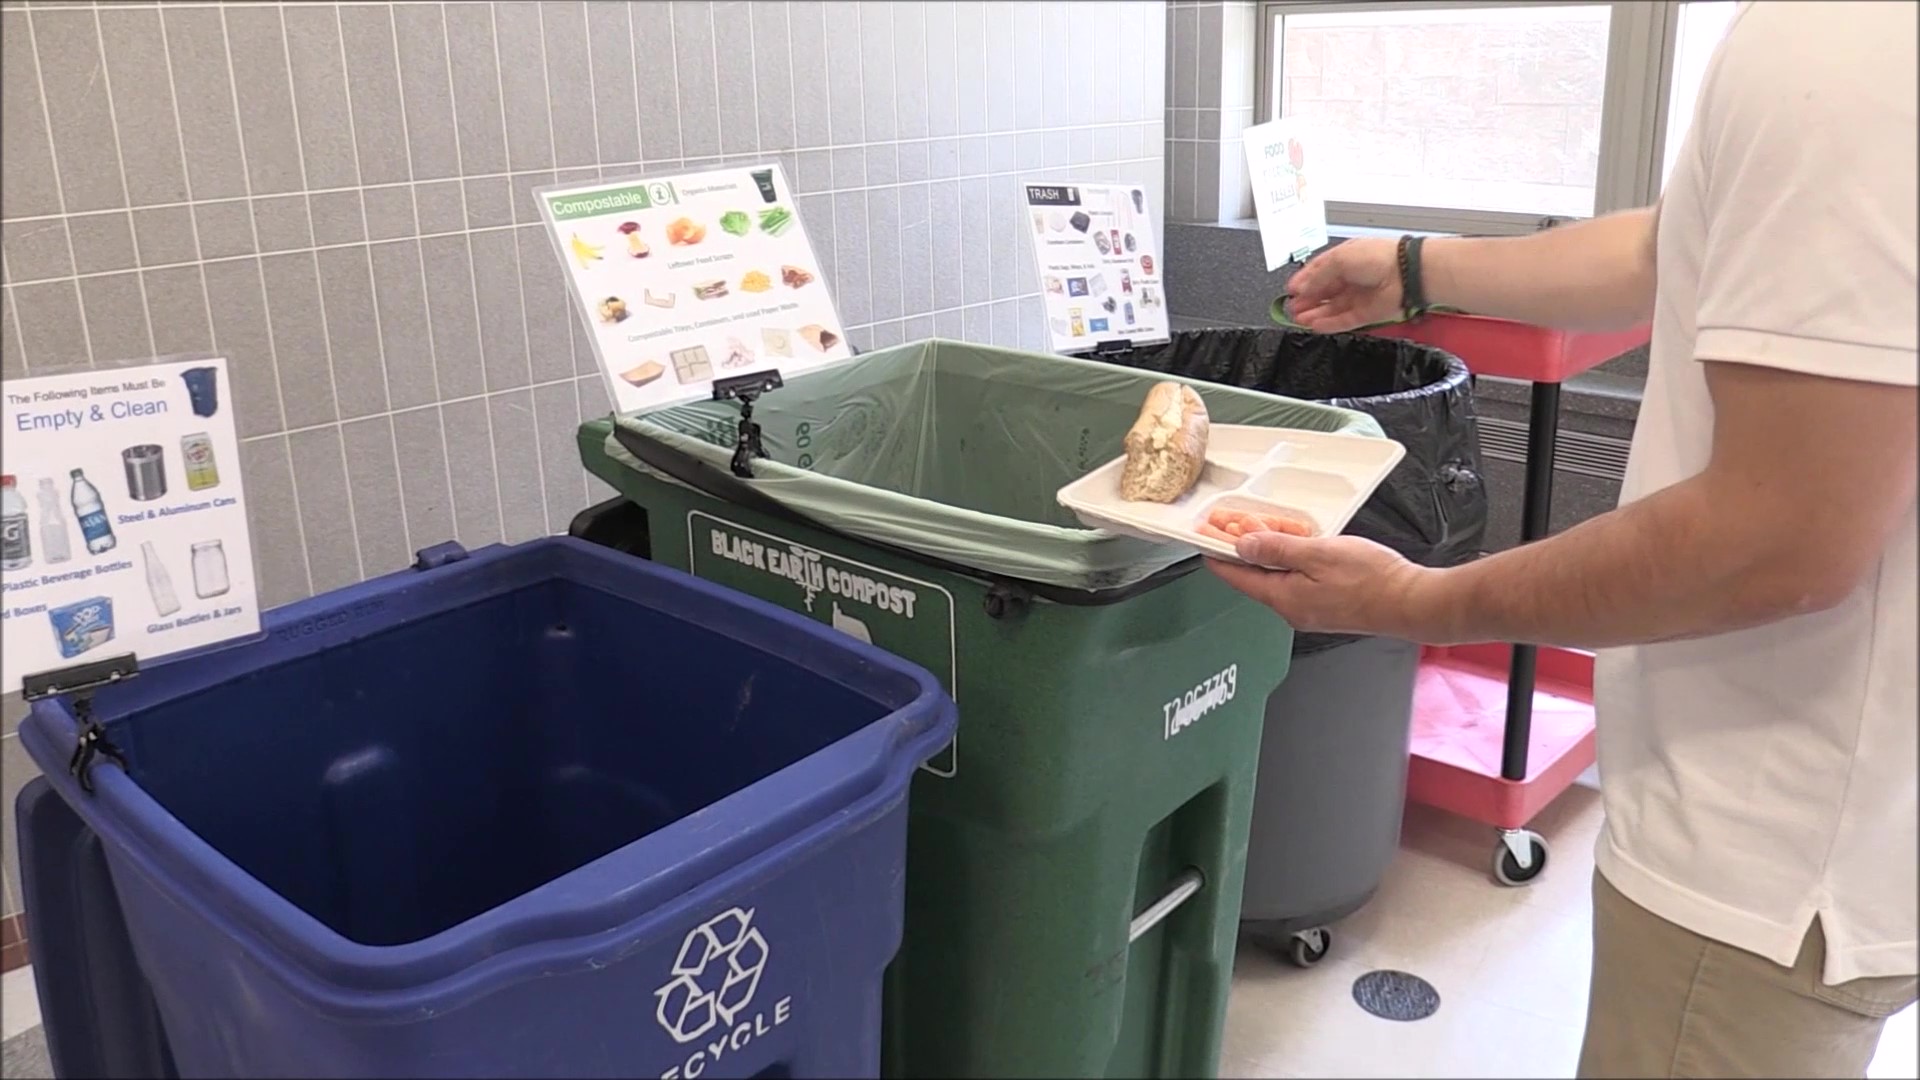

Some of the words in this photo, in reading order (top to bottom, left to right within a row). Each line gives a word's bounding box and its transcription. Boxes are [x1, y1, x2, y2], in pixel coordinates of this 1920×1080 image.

[552, 190, 642, 216] Compostable
[1028, 188, 1060, 200] TRASH
[7, 394, 31, 405] The
[33, 387, 88, 403] Following
[90, 384, 120, 396] Items
[122, 381, 148, 392] Must
[151, 378, 166, 388] Be
[16, 409, 84, 432] Empty
[90, 404, 105, 421] &
[111, 399, 169, 420] Clean
[118, 511, 145, 524] Steel
[147, 509, 157, 519] &
[159, 502, 211, 517] Aluminum
[213, 498, 236, 508] Cans
[0, 578, 39, 592] Plastic
[41, 567, 93, 585] Beverage
[95, 560, 133, 575] Bottles
[711, 529, 766, 570] BLACK
[767, 546, 824, 592] EARTH
[826, 567, 916, 619] COMPOST
[14, 603, 47, 617] Boxes
[147, 620, 174, 634] Glass
[176, 612, 211, 627] Bottles
[213, 609, 222, 619] &
[223, 604, 242, 617] Jars
